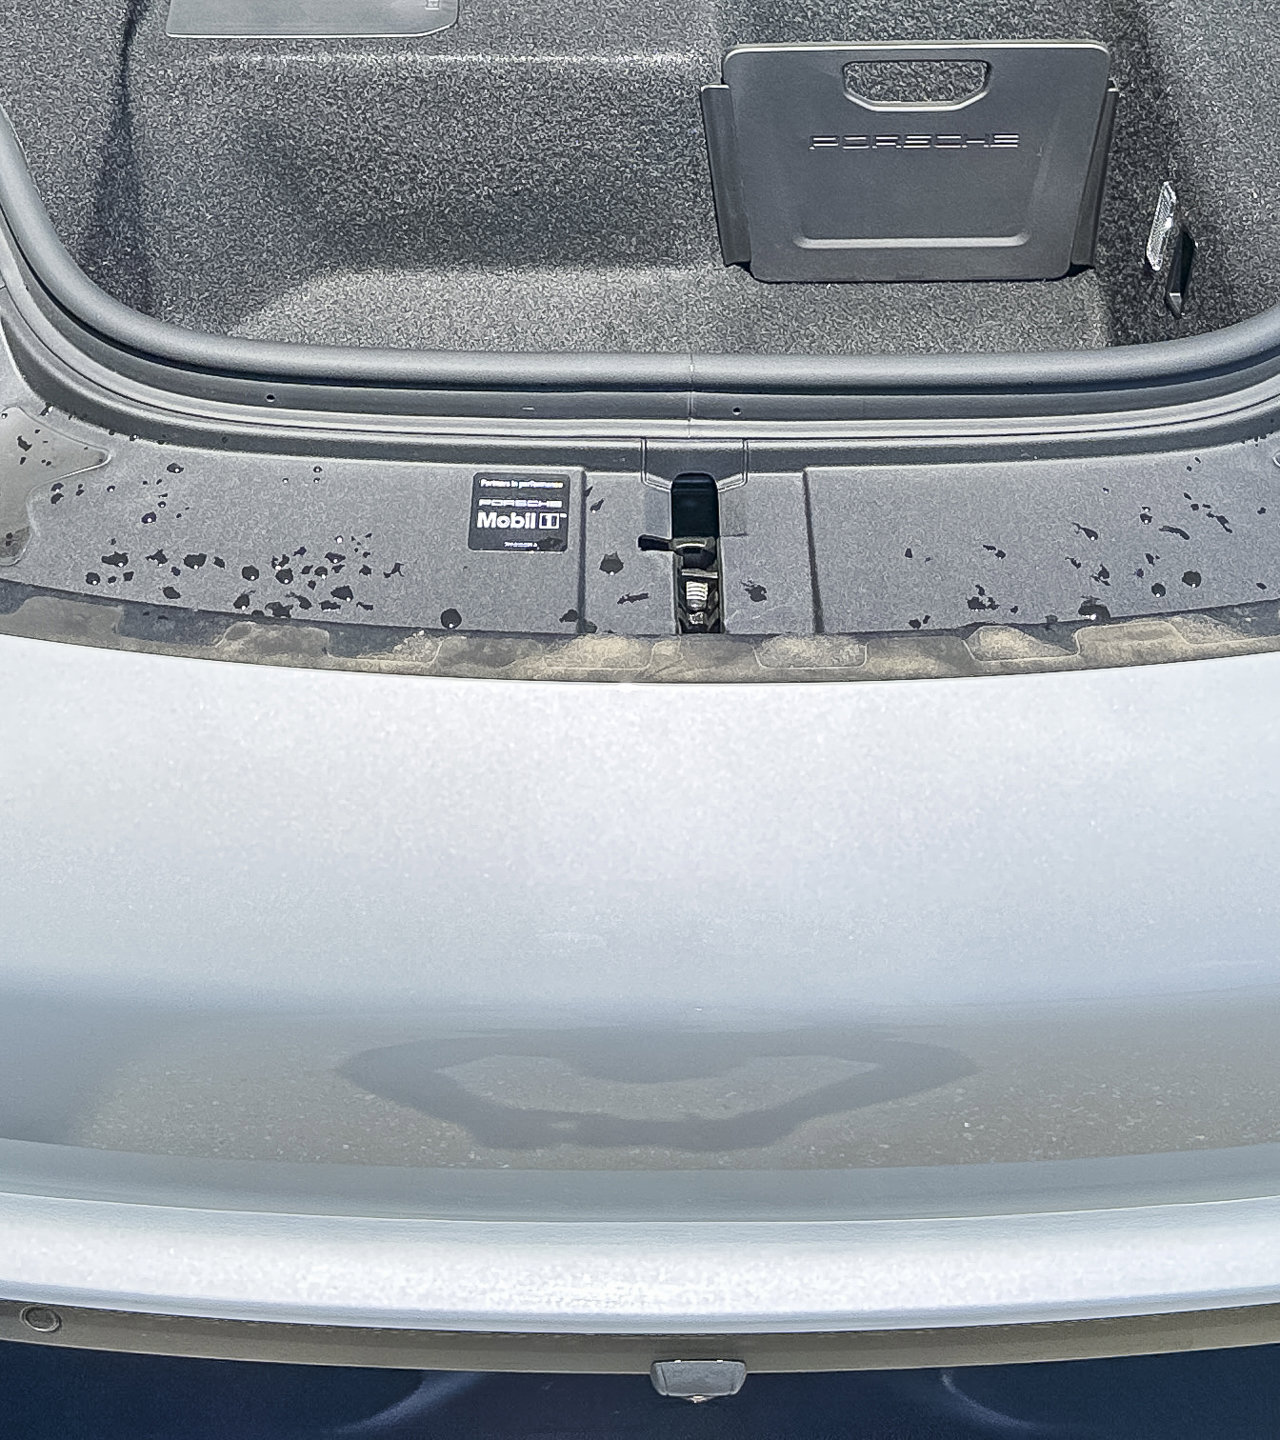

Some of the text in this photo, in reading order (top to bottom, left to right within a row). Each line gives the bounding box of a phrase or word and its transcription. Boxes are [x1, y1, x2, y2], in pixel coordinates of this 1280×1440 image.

[807, 132, 1021, 151] PORSCHE
[478, 498, 563, 508] PORSCHE
[476, 510, 536, 529] Mobil
